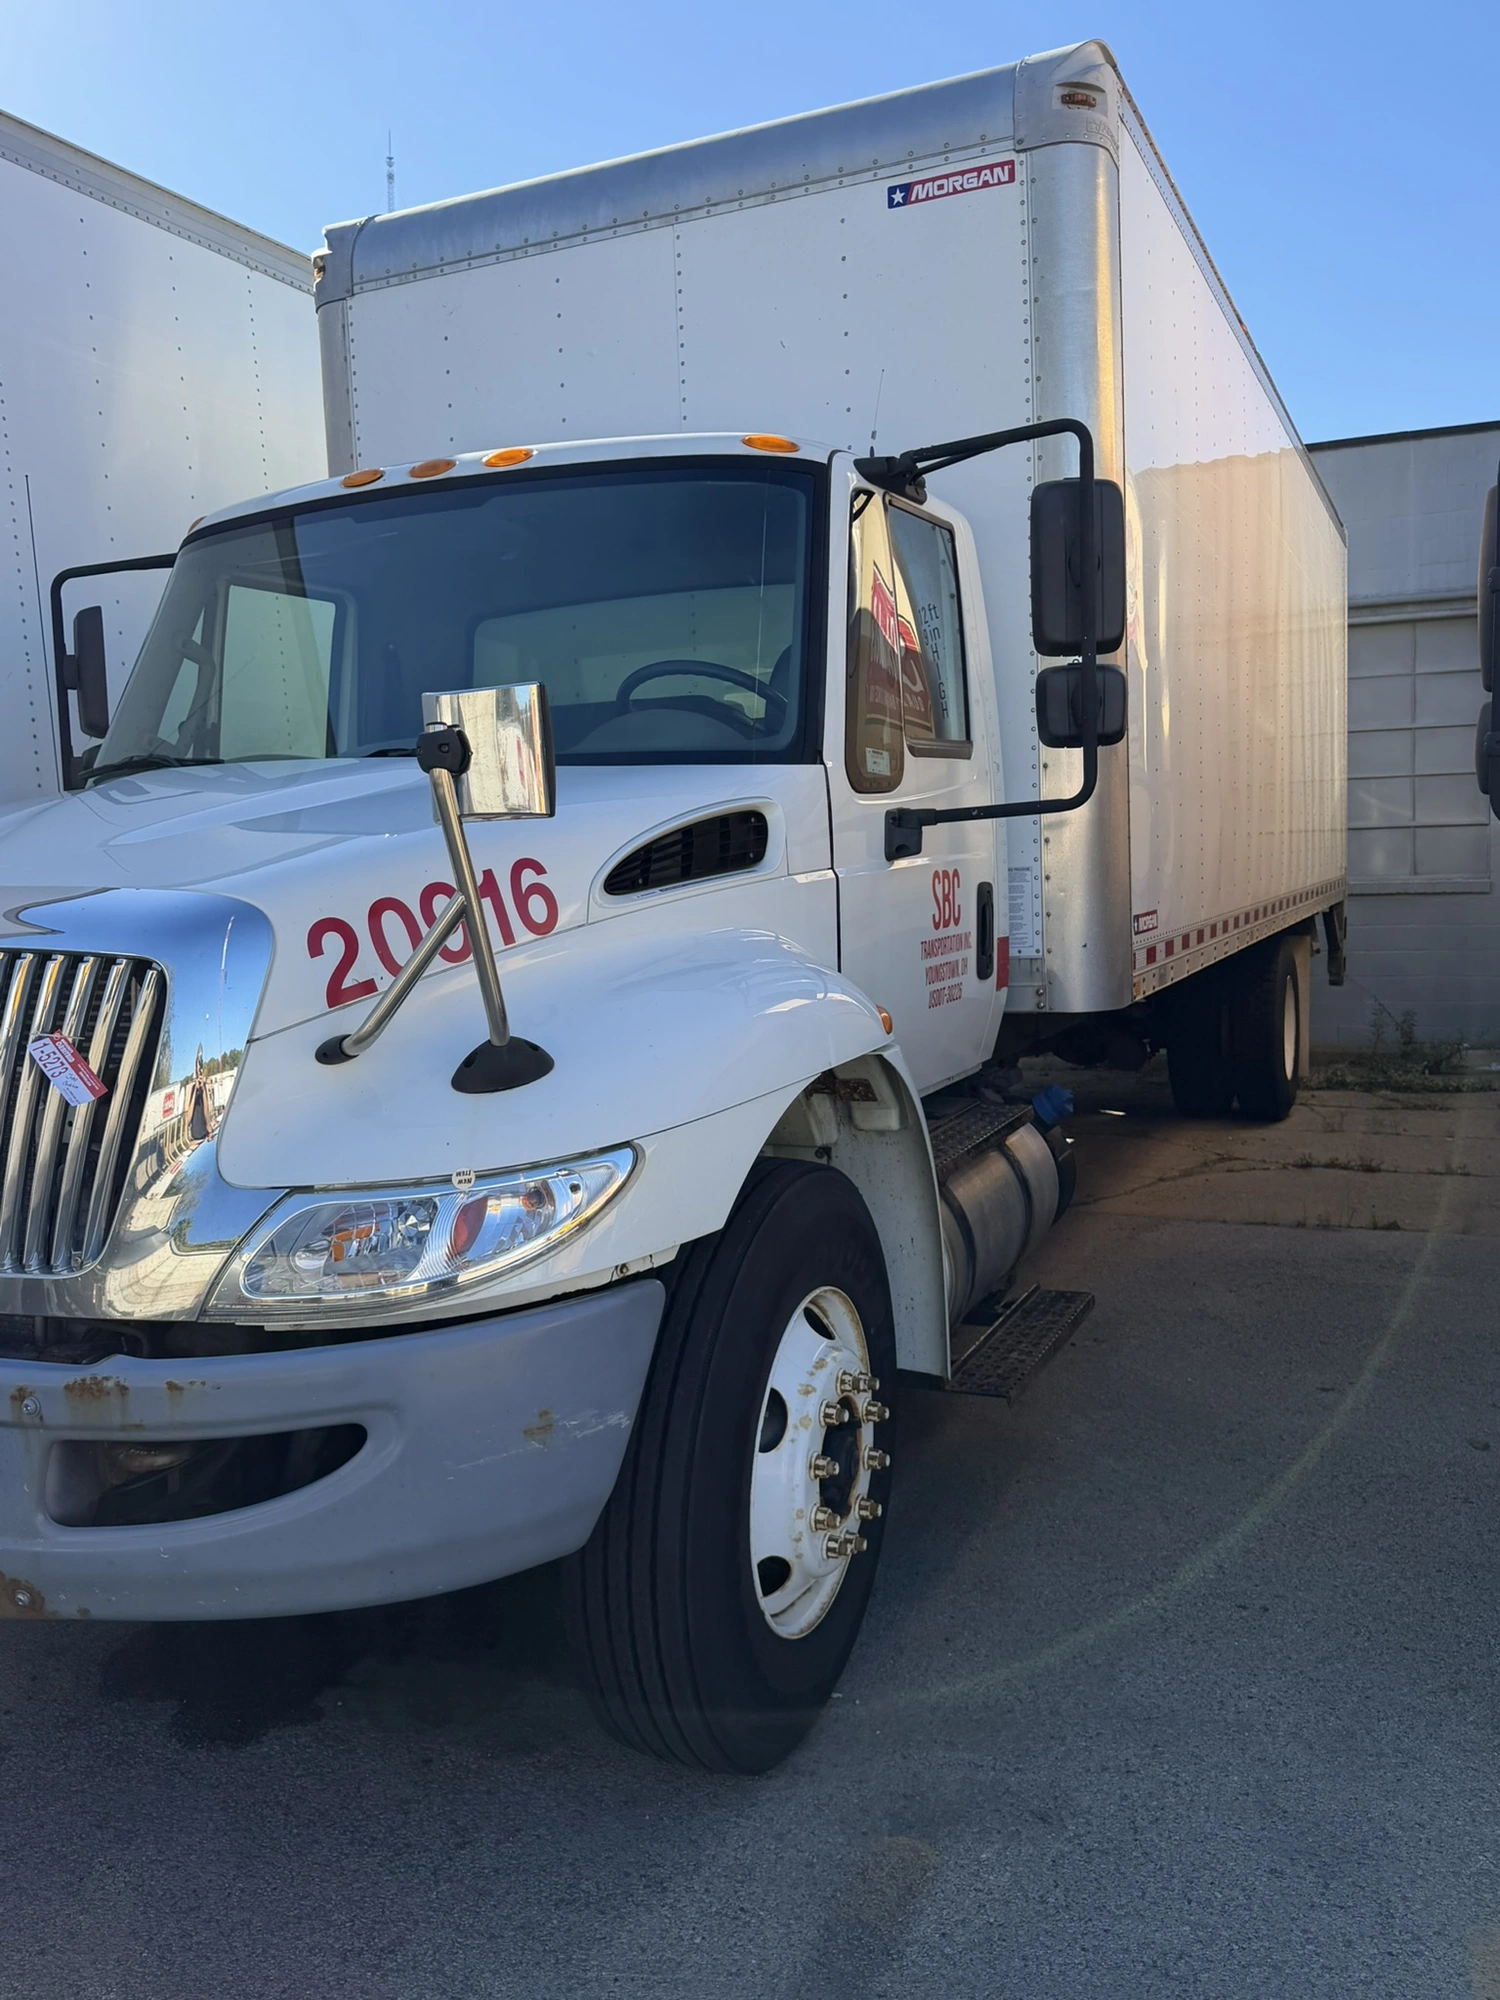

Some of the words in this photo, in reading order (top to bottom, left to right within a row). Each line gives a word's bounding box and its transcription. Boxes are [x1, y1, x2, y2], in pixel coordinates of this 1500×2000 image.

[910, 165, 1010, 202] MORGAN
[930, 642, 949, 719] HIGH
[932, 868, 961, 930] SBC
[921, 935, 963, 960] TRANSPORTATION
[32, 1042, 69, 1079] 1-5273
